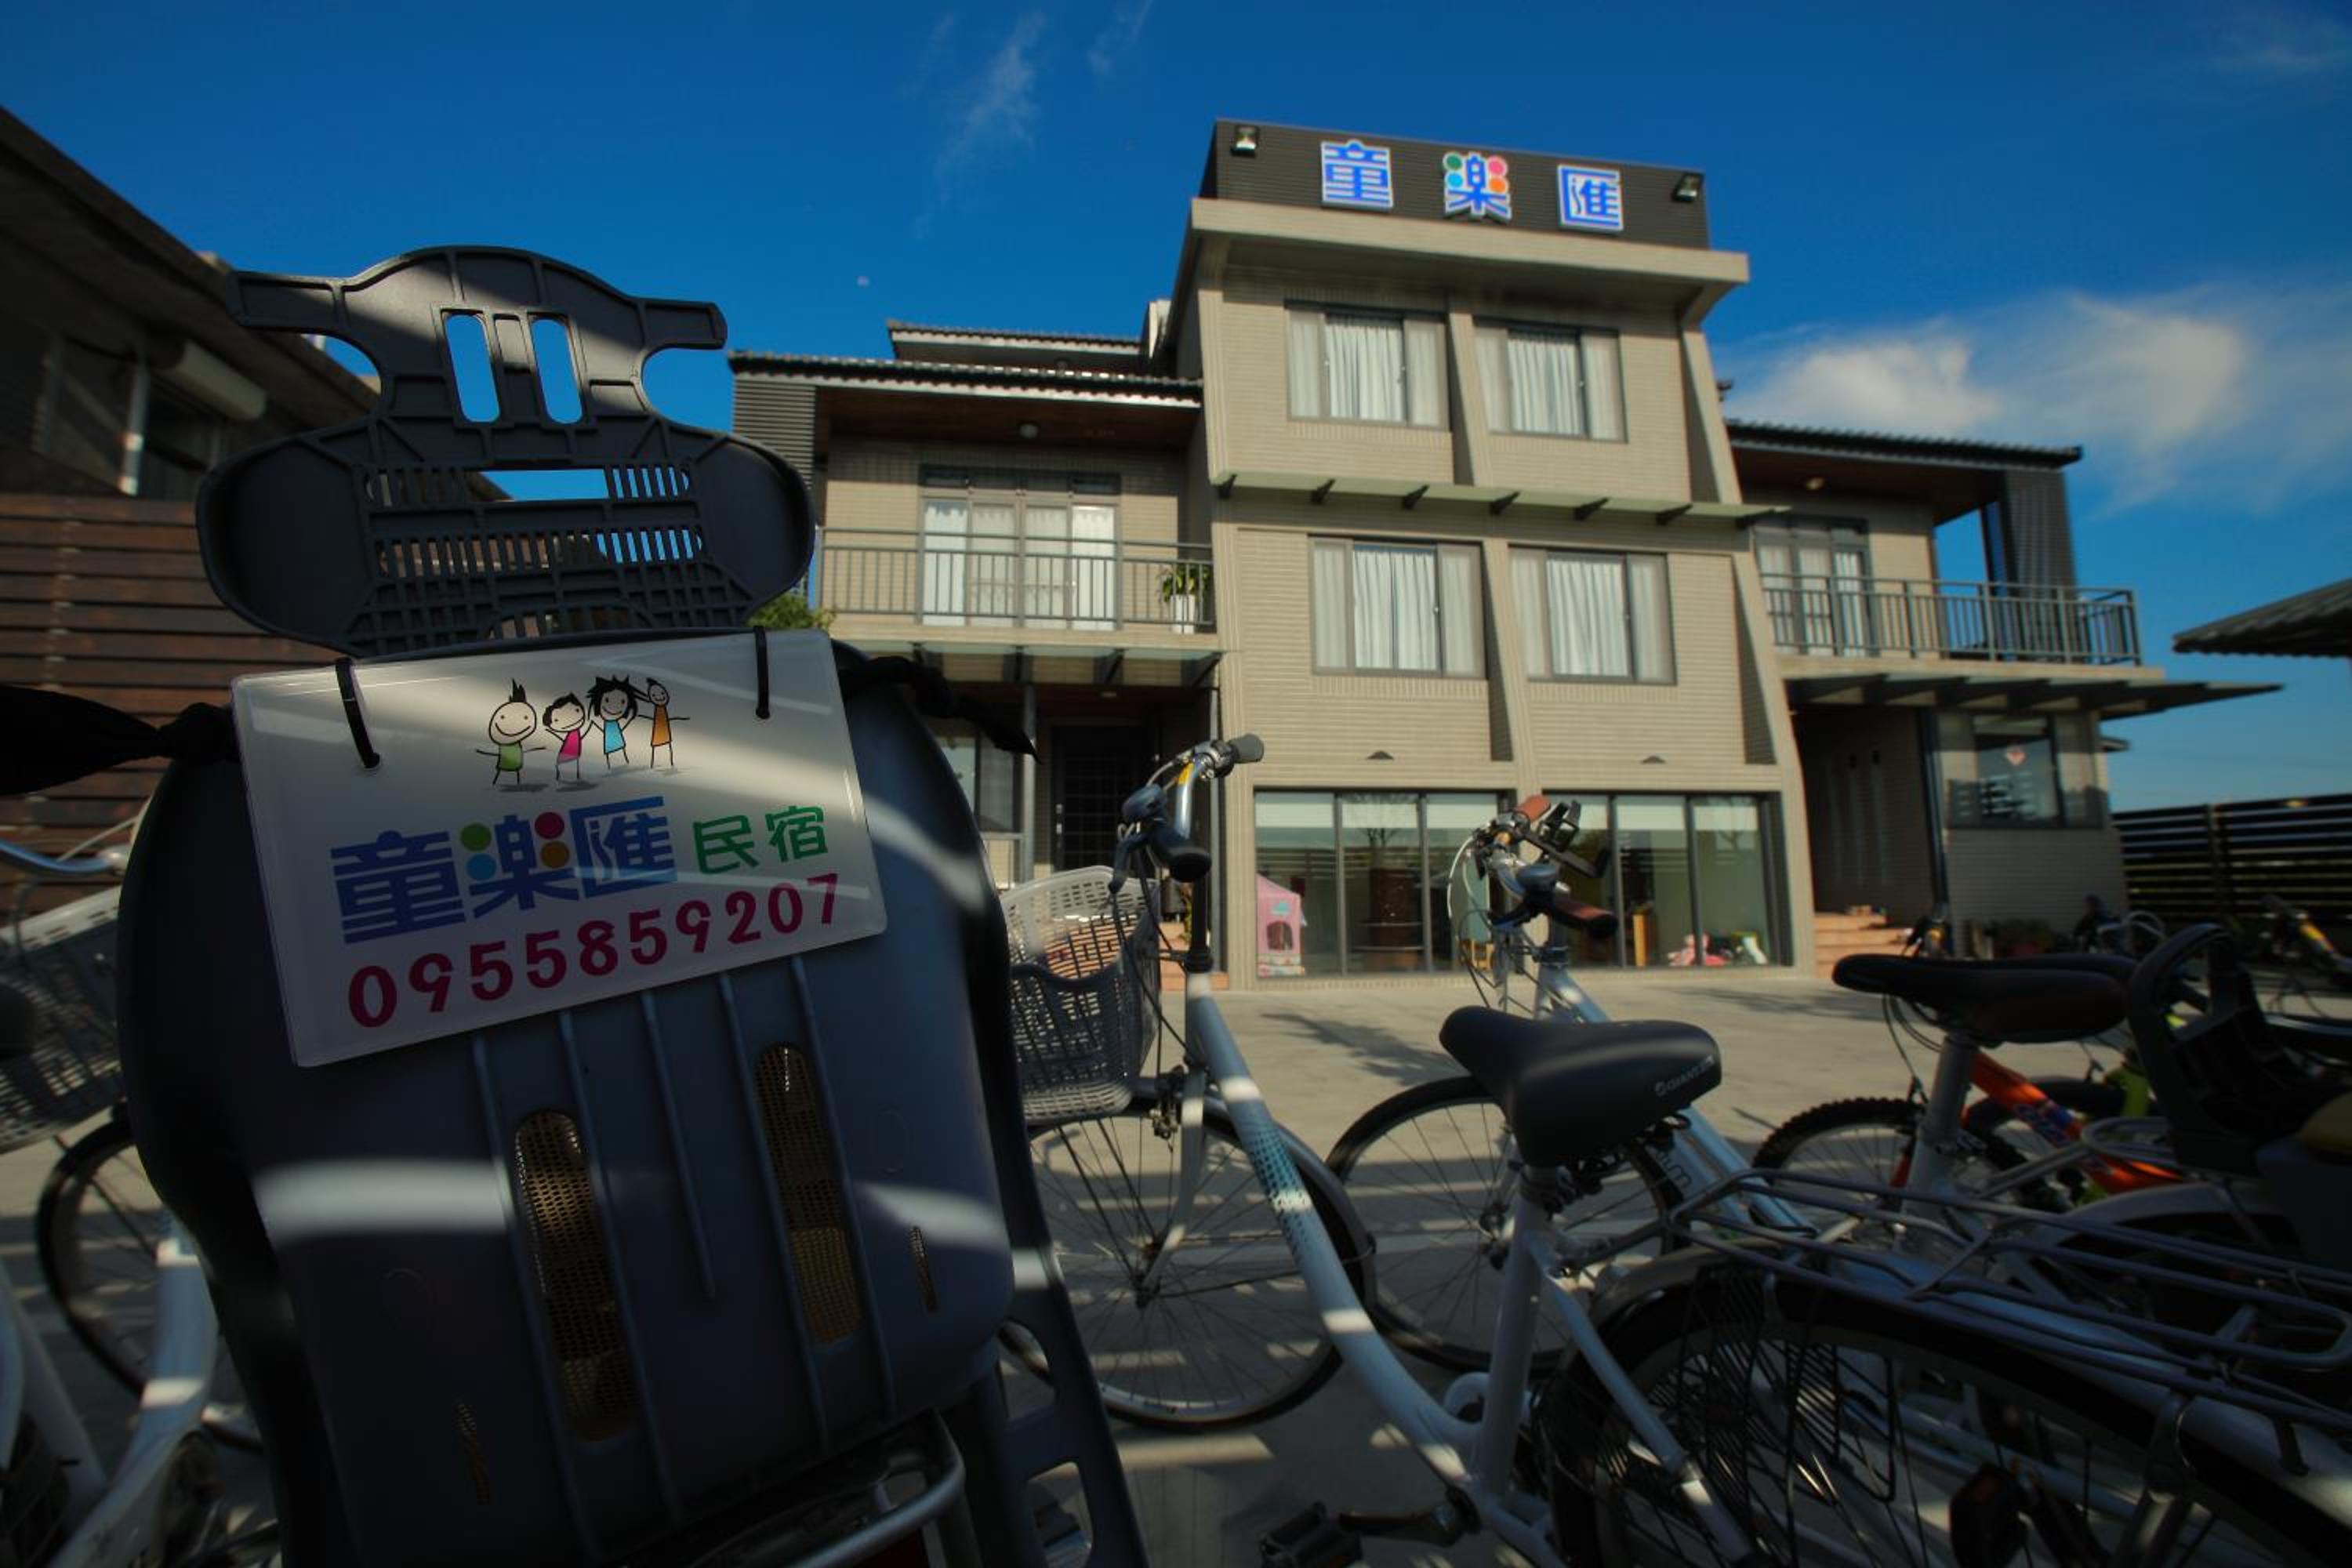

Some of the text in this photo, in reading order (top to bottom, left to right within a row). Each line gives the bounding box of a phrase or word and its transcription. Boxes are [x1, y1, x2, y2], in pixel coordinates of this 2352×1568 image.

[1320, 139, 1624, 231] 童樂匯
[331, 796, 828, 944] 童樂匯 民宿
[348, 873, 840, 1027] 0955859207
